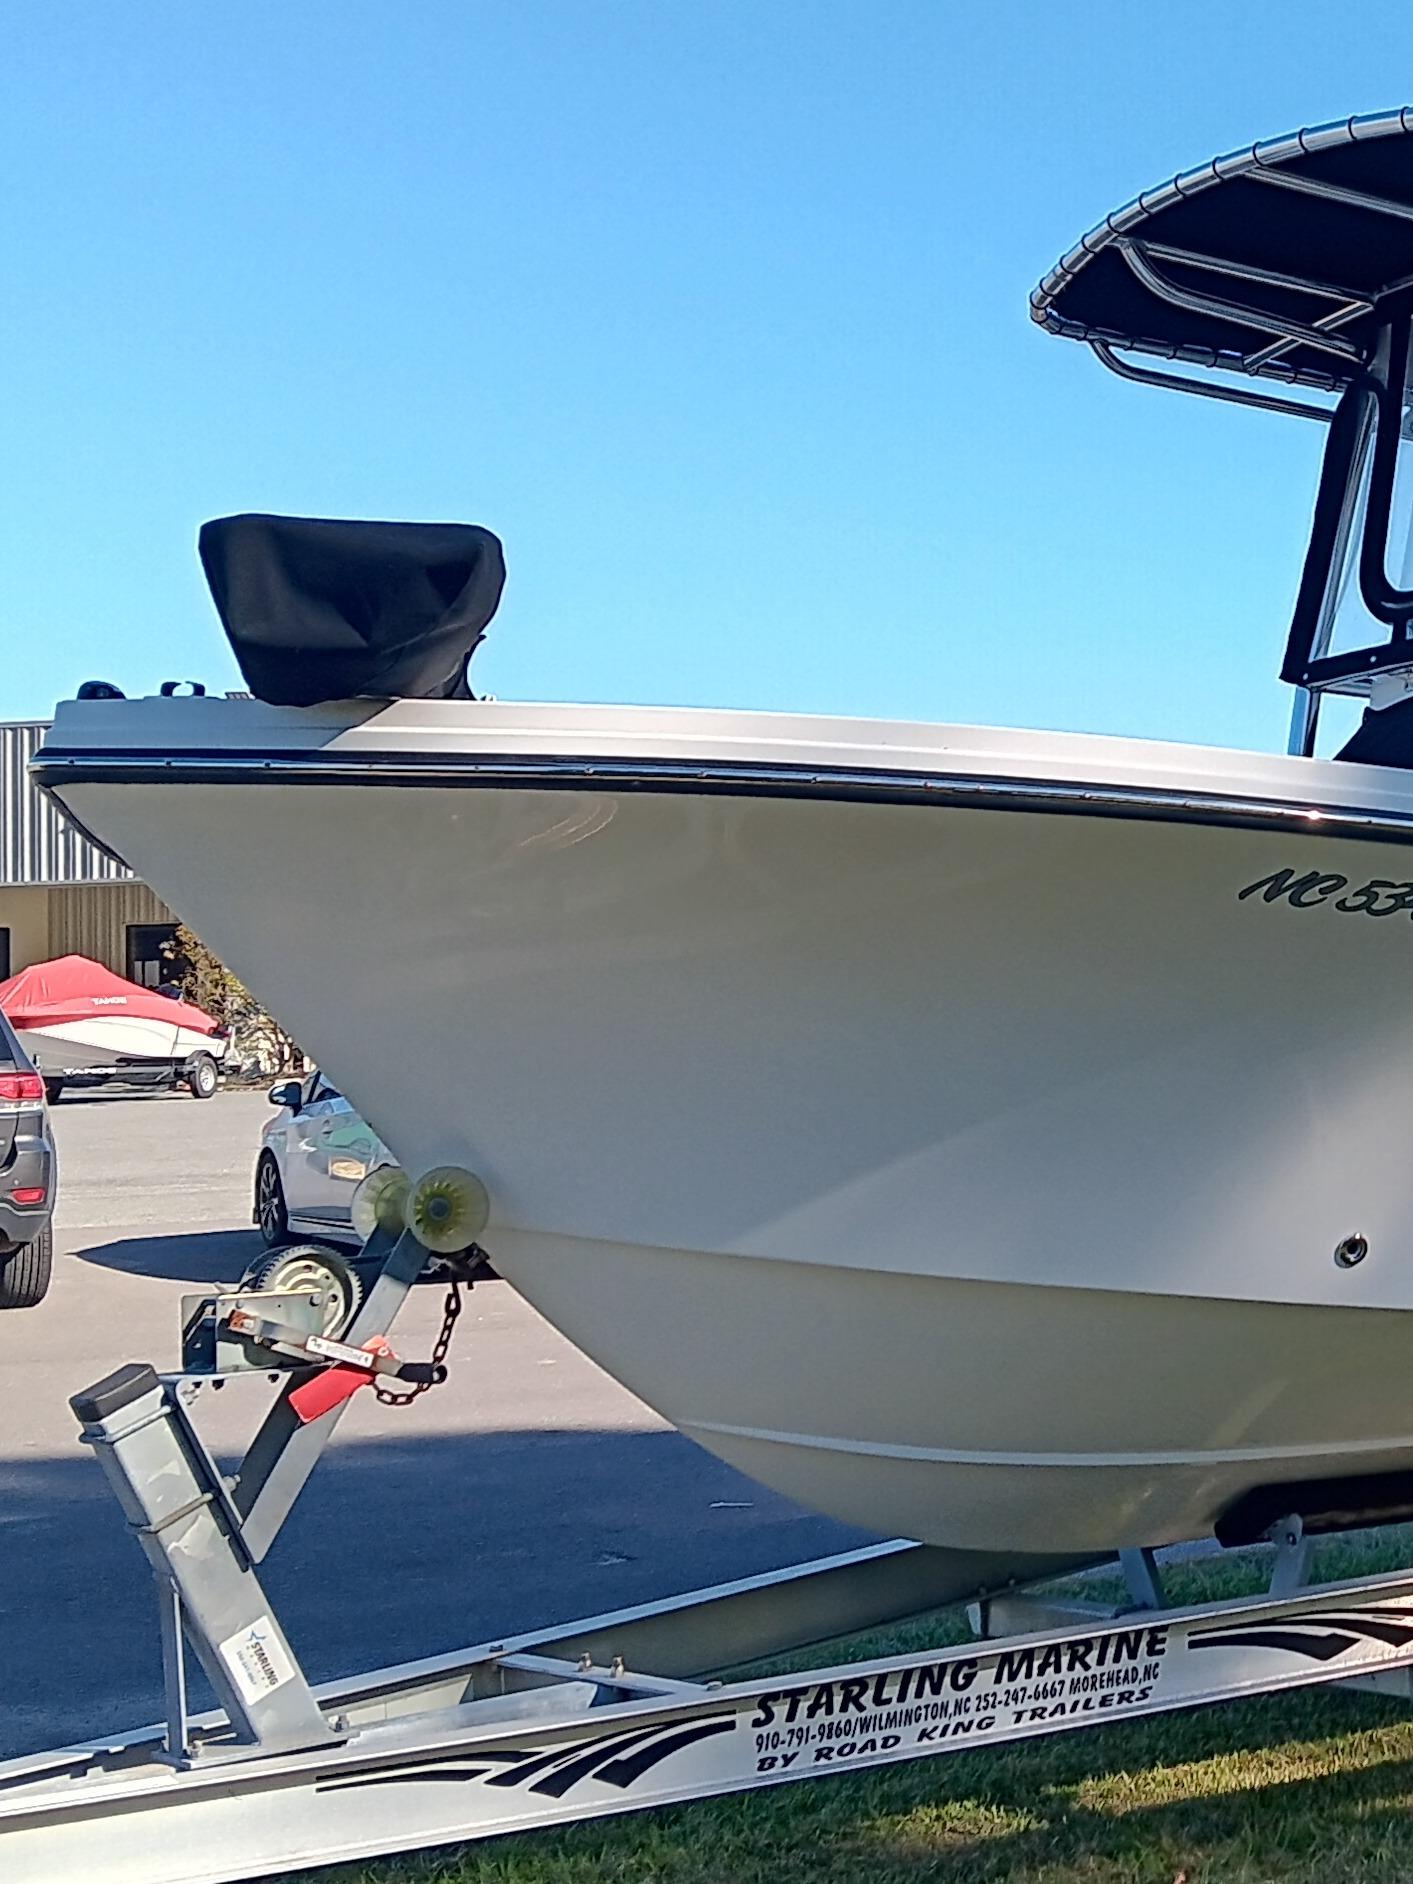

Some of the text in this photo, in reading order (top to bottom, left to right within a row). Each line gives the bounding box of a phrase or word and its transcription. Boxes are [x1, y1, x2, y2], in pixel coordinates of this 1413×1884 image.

[1238, 868, 1348, 908] NC
[250, 1641, 279, 1686] STARLING
[751, 1624, 1169, 1728] STARLING MARINE
[975, 1679, 1065, 1714] 252-247-6667
[1068, 1661, 1161, 1695] MOREHEAD,NC
[757, 1685, 1154, 1772] BY ROAD KING TRAILERS
